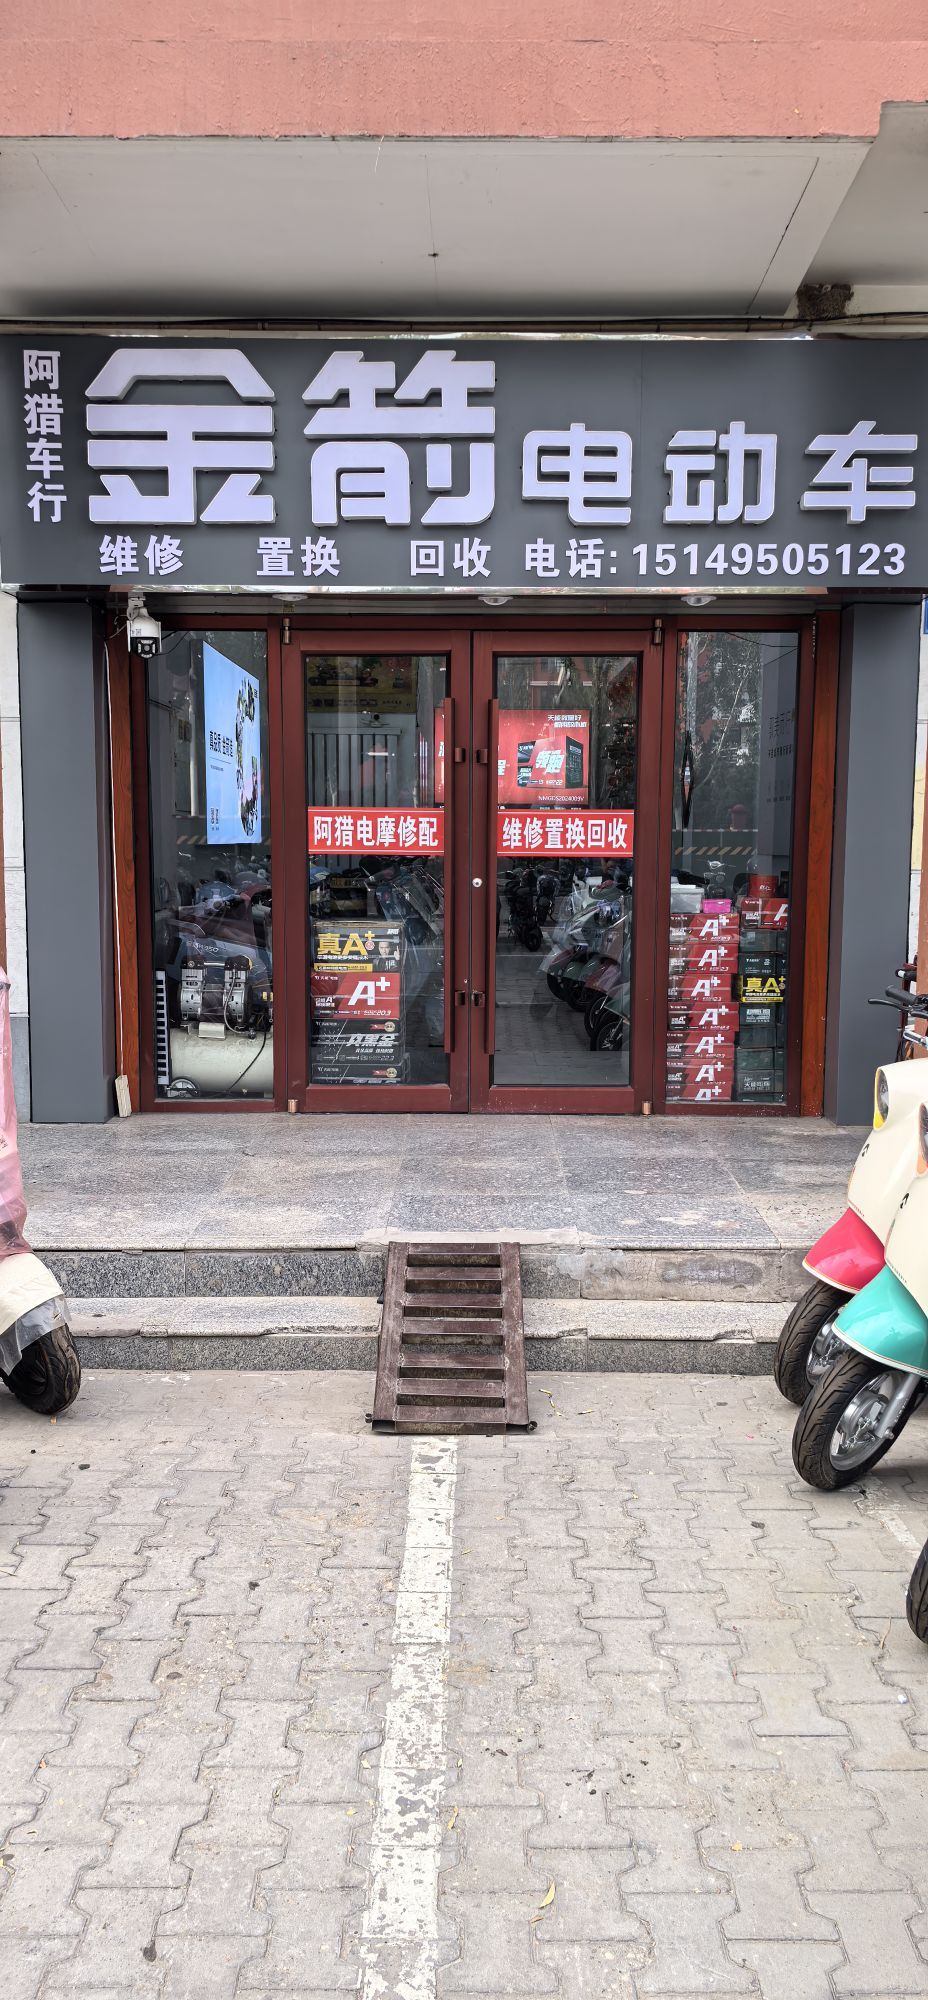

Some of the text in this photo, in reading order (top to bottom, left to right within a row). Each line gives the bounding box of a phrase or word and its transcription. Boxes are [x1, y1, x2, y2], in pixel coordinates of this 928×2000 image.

[22, 349, 67, 523] 阿猎车行
[99, 534, 184, 577] 维修
[256, 536, 341, 577] 置换
[409, 537, 492, 578] 回收
[313, 815, 439, 847] 阿猎电摩修配
[502, 817, 628, 849] 维修置换回收
[699, 914, 730, 937] A+
[317, 930, 376, 956] 真A+
[698, 946, 728, 967] A+
[347, 976, 391, 1006] A+
[691, 975, 721, 997] A+
[746, 975, 787, 993] 真A+
[699, 1004, 729, 1025] A+
[694, 1033, 724, 1054] A+
[695, 1061, 724, 1082] A+
